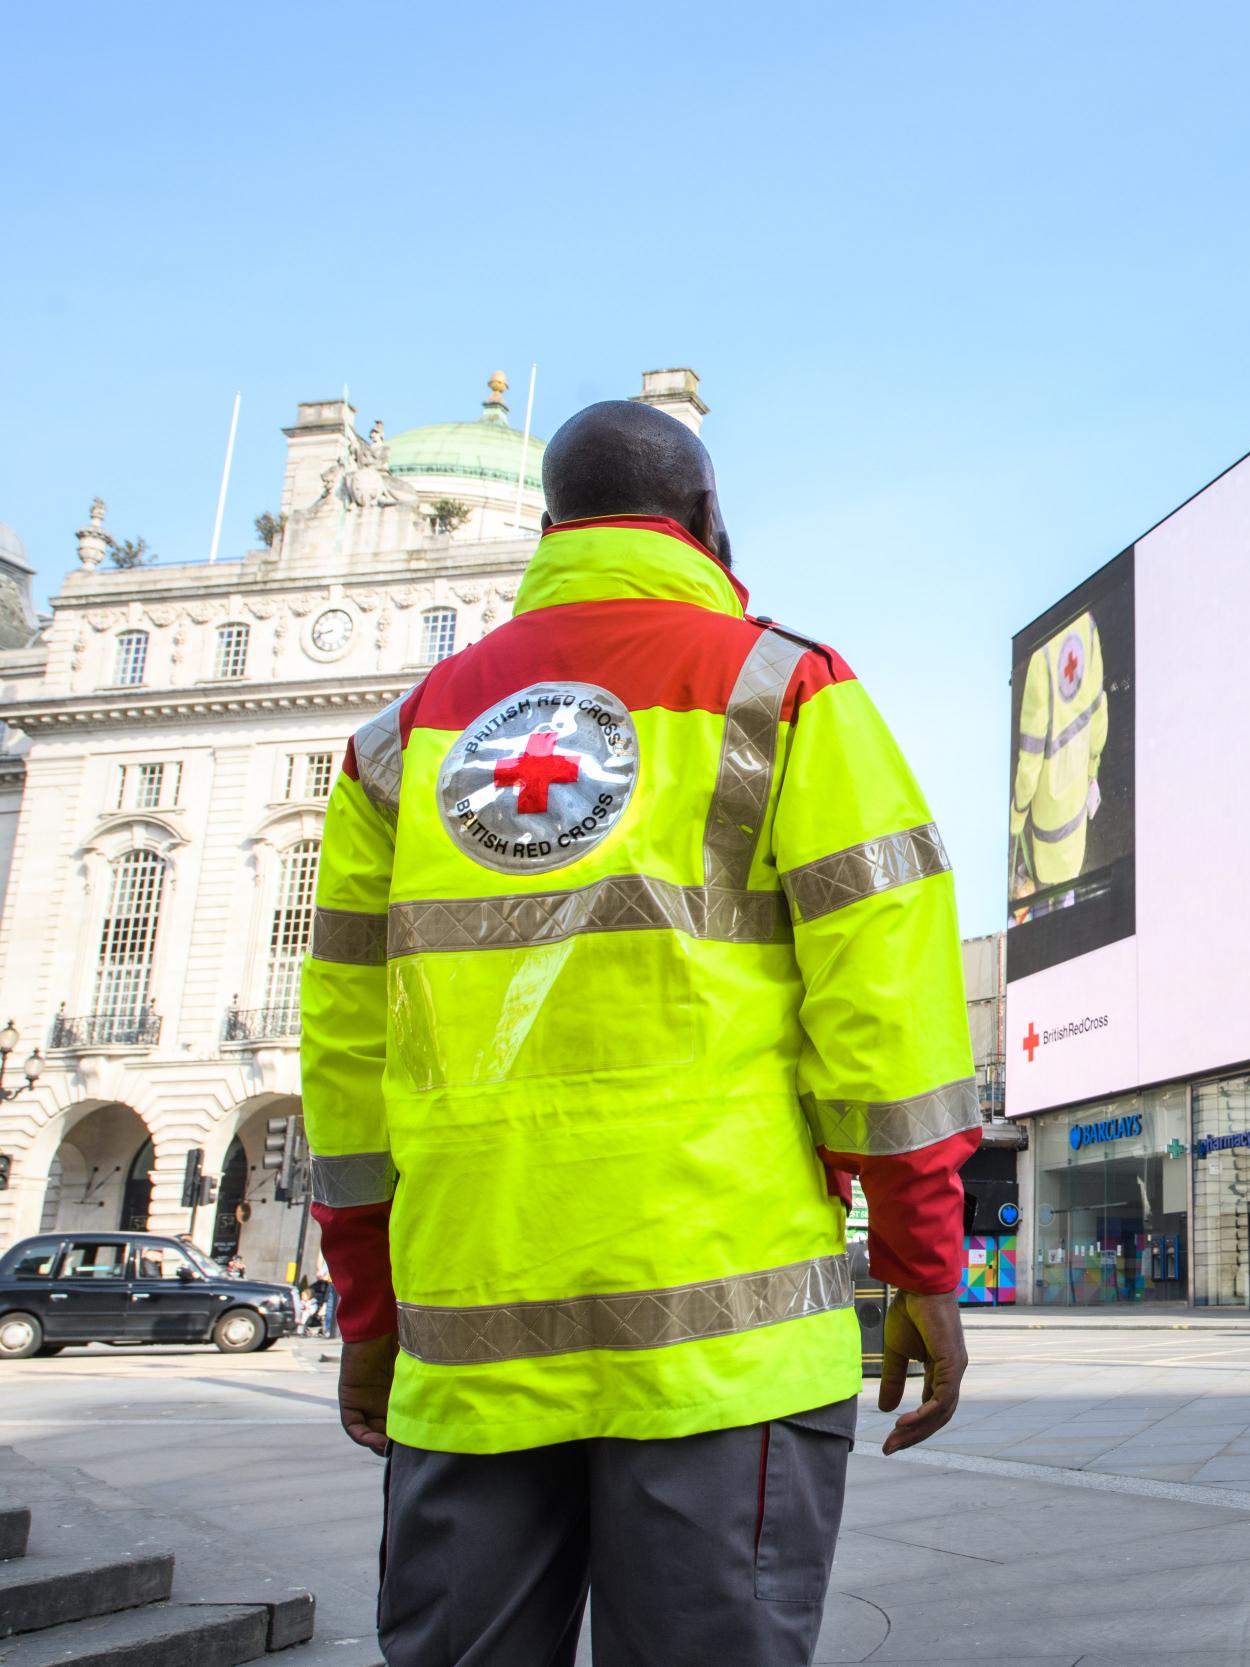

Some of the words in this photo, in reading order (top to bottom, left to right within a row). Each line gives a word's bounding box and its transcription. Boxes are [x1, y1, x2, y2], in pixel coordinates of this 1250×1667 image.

[465, 699, 531, 754] BRITISH
[536, 694, 577, 708] RED
[578, 699, 621, 747] CROSS
[456, 798, 509, 855] BRITISH
[512, 840, 552, 859] RED
[557, 792, 613, 848] CROSS
[1082, 1114, 1142, 1146] BARCLAYS
